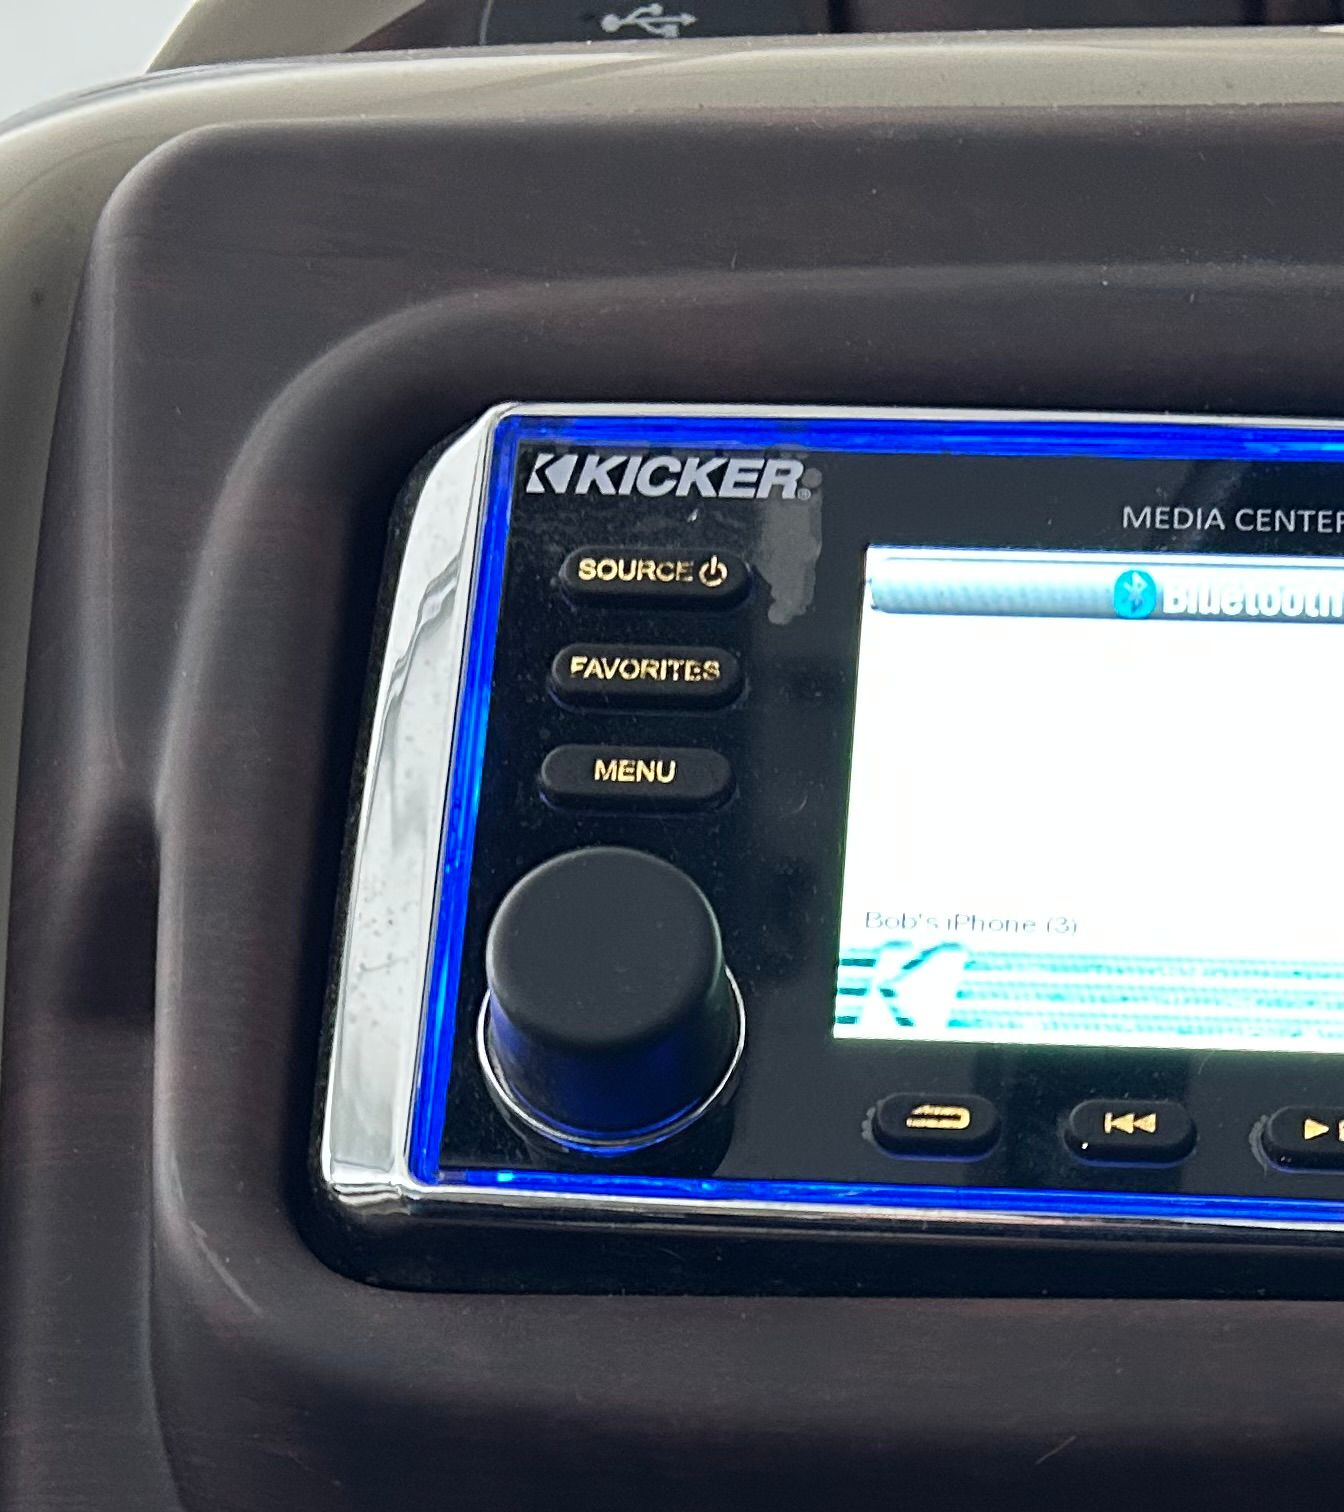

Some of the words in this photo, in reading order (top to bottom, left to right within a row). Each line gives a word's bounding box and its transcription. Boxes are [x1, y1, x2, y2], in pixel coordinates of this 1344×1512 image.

[575, 454, 804, 499] KICKER
[1121, 505, 1226, 533] MEDIA
[577, 558, 695, 584] SOURCE
[1162, 577, 1344, 618] Bluetooth
[569, 656, 721, 683] FAVORITES
[593, 759, 677, 785] MENU
[864, 910, 939, 931] Bob's
[947, 914, 1037, 934] iPhone
